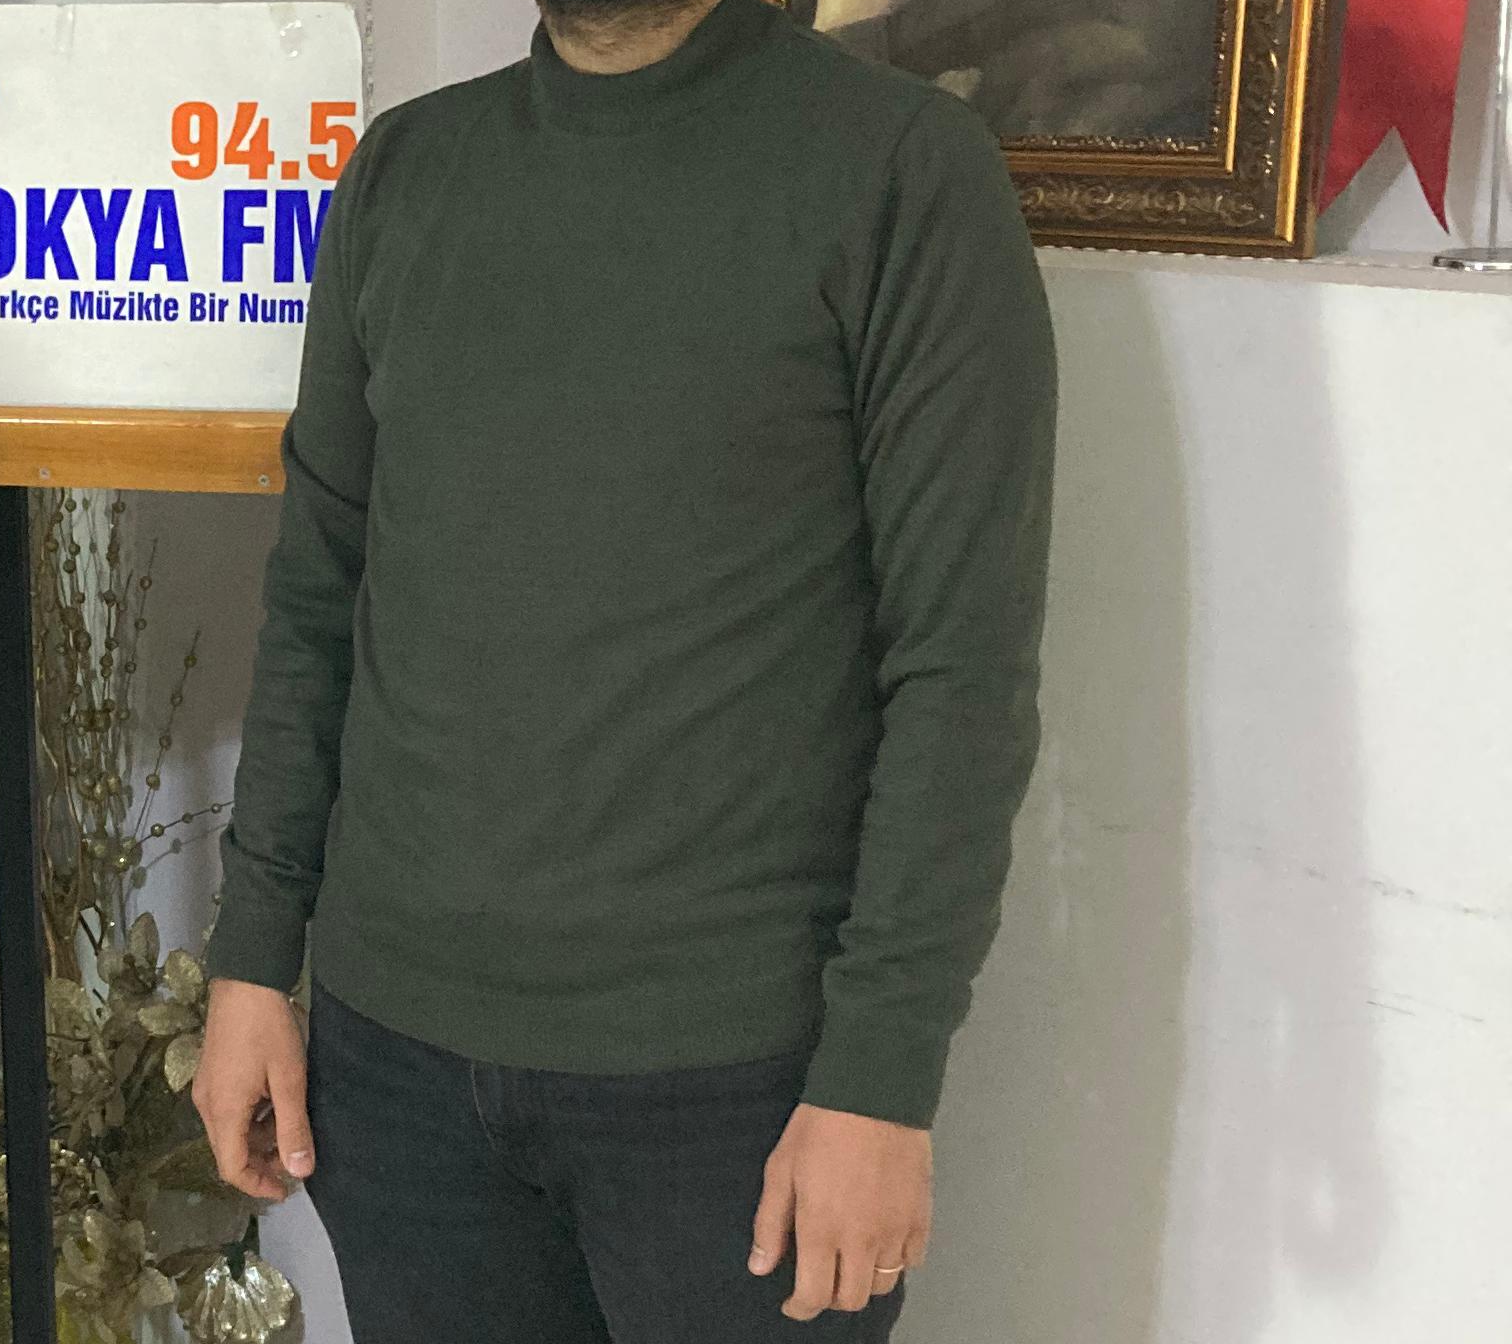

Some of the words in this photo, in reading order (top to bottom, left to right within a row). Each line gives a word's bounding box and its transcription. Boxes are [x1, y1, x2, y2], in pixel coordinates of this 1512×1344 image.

[171, 101, 358, 181] 94.5
[221, 189, 334, 284] FM
[70, 290, 179, 323] Müzikte
[189, 292, 229, 323] Bir
[239, 292, 308, 324] Num
